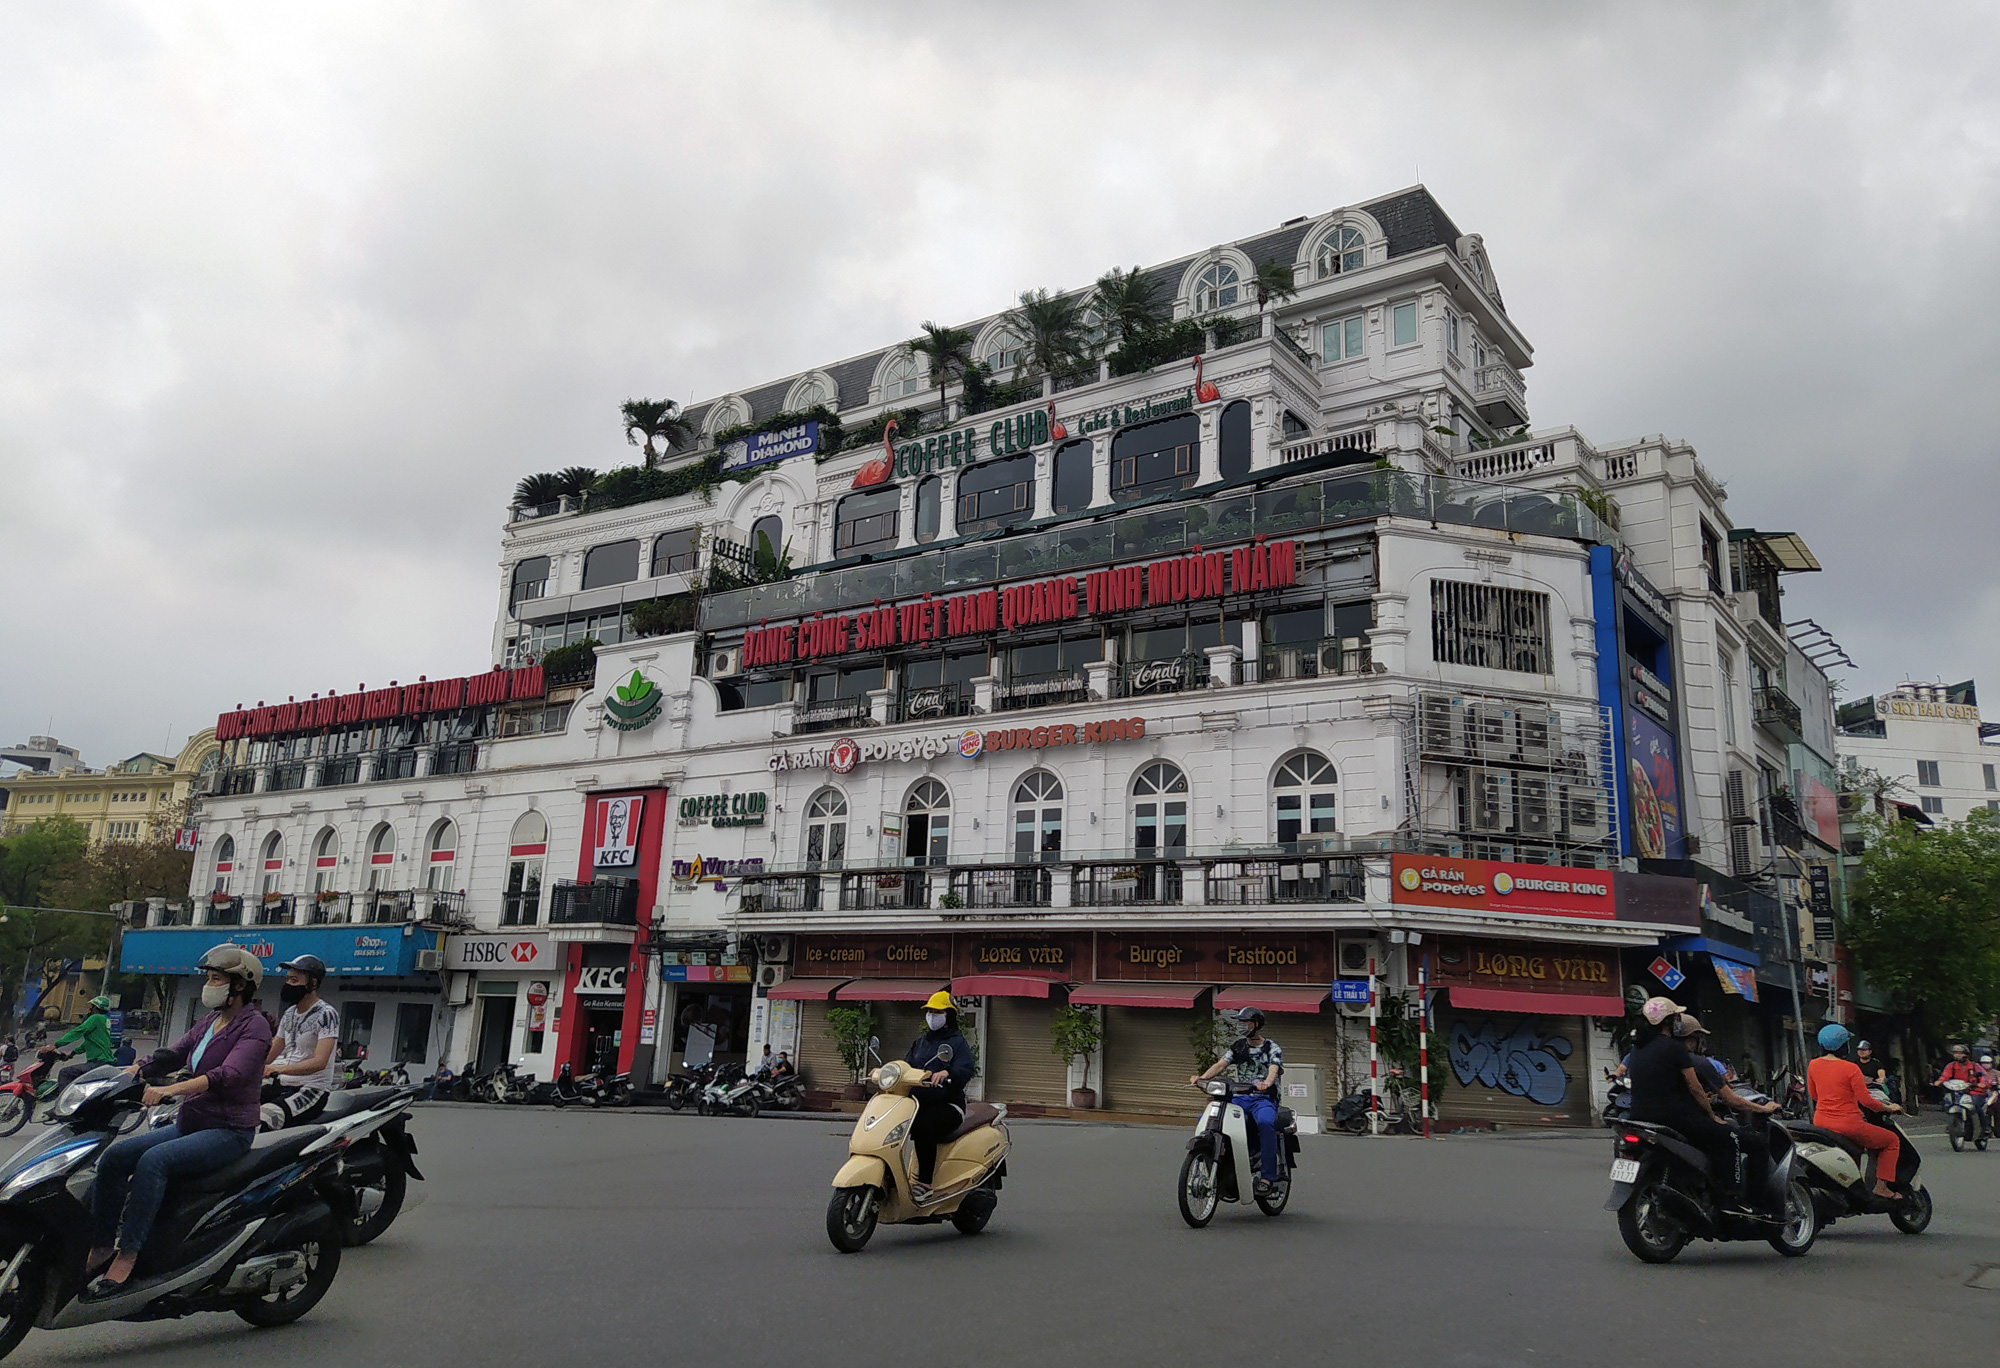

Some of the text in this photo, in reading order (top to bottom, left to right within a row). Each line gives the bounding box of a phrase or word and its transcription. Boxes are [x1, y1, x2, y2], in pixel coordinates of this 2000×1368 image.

[1078, 390, 1194, 435] Café & Restaurant
[757, 425, 806, 447] MINH
[897, 409, 1048, 478] COFFEE CLUB
[751, 437, 812, 462] DIAMOND
[713, 537, 751, 563] COFFEE
[742, 533, 1296, 668] ĐẢNG CỘNG SẢN VIỆT NAM QUANG VINH MUÔN NĂM
[430, 677, 466, 711] NAM
[1891, 701, 1979, 719] SKY BAR CAFE
[960, 734, 980, 745] BURGER
[986, 716, 1146, 751] BURGER KING
[960, 740, 980, 752] KING
[767, 747, 827, 771] GÀ RÁN
[680, 792, 766, 818] COFFEE CLUB
[598, 849, 629, 864] KFC
[1421, 866, 1464, 882] GÀ RÁN
[1514, 878, 1607, 896] BURGER KING
[462, 941, 508, 963] HSBC
[887, 944, 928, 961] Coffee
[979, 944, 1064, 964] LONG VÂN
[1130, 945, 1297, 968] Burger Fastfood
[576, 966, 627, 989] KFC
[1476, 952, 1607, 983] LONG VÂN
[1334, 989, 1342, 999] LÊ
[1343, 990, 1358, 999] THÁI
